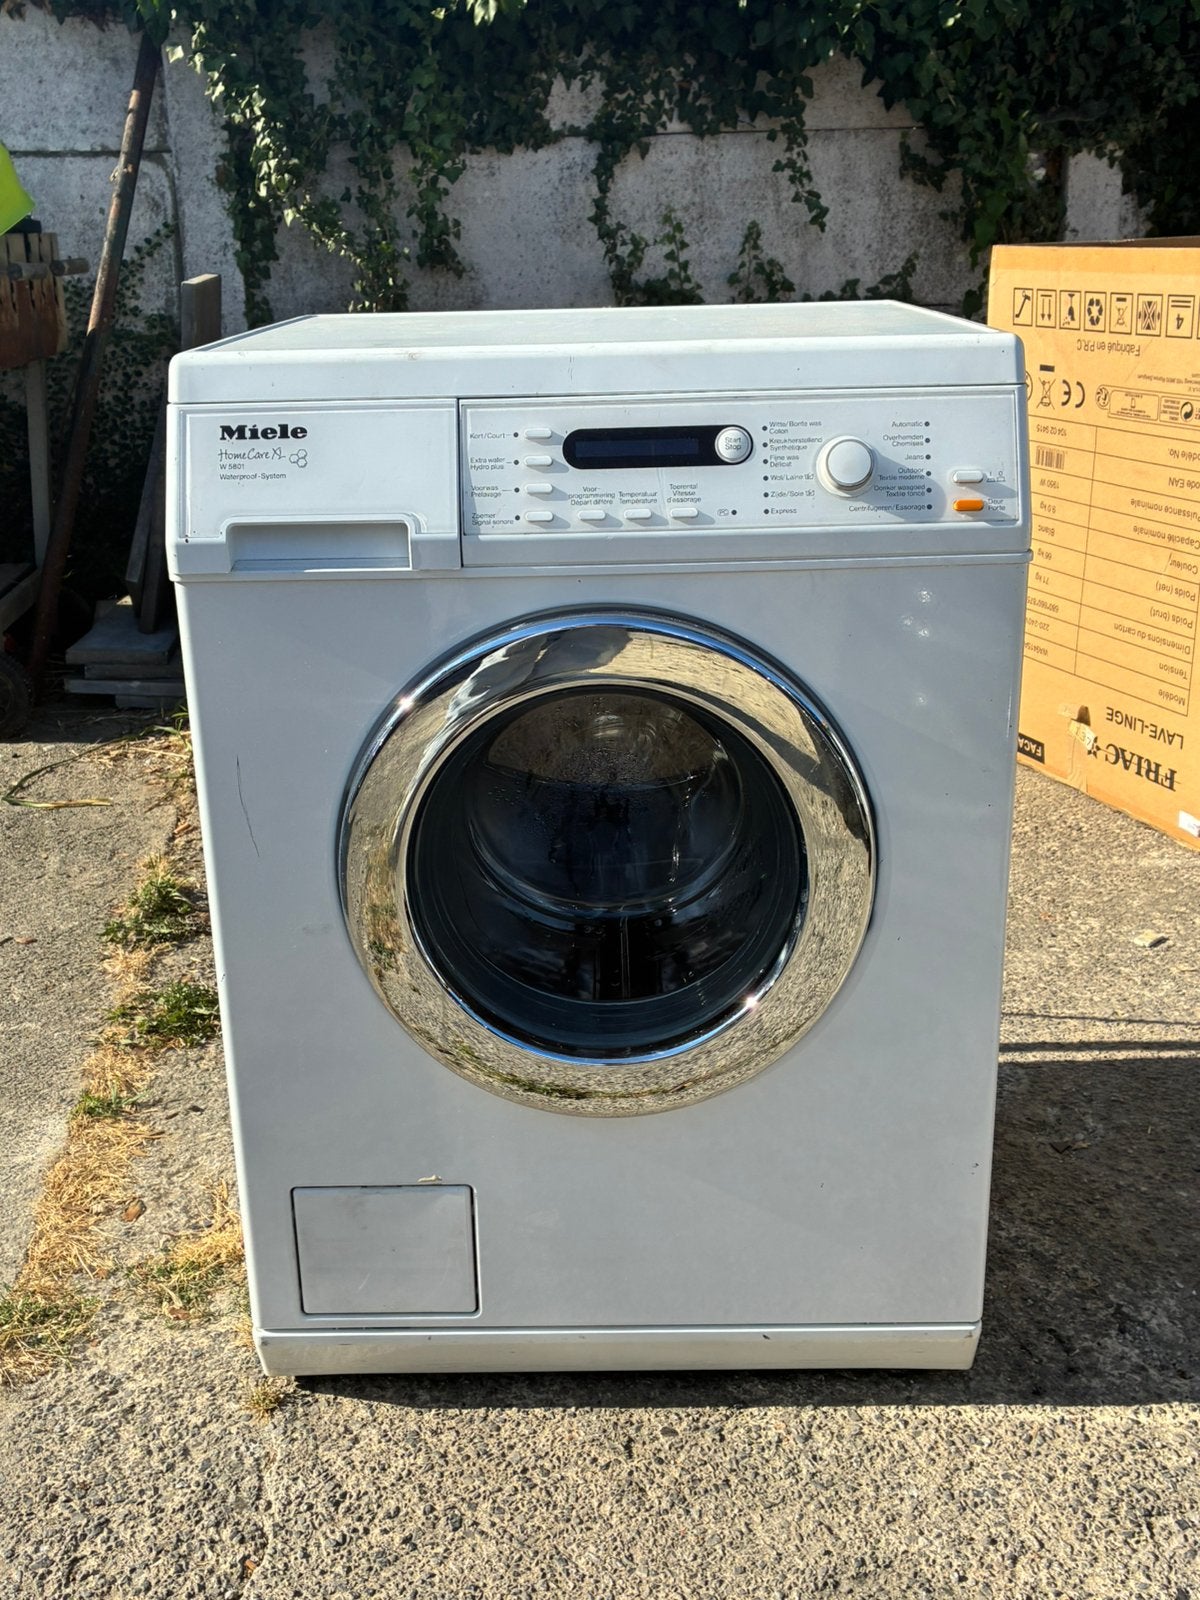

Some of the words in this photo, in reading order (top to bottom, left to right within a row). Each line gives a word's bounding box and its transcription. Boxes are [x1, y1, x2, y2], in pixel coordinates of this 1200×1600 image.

[1096, 341, 1107, 350] en
[219, 423, 309, 440] Miele
[904, 453, 925, 461] Jeans
[1181, 450, 1200, 462] odèle
[470, 464, 490, 472] Hydro
[1168, 477, 1185, 489] EAN
[1187, 480, 1200, 490] ode
[770, 507, 797, 515] Express
[1130, 498, 1162, 513] nominale
[1133, 525, 1165, 541] nominale
[1170, 559, 1199, 575] Couleur
[1156, 580, 1174, 595] (net)
[1175, 588, 1196, 602] Poids
[1149, 607, 1170, 621] (brut)
[1114, 623, 1136, 634] carton
[1170, 615, 1194, 629] Poids
[1137, 631, 1147, 640] du
[1148, 633, 1191, 655] Dimensions
[1159, 663, 1188, 680] Tension
[1158, 690, 1186, 706] Modèle
[1106, 706, 1184, 750] LAVE-LINGE
[1017, 736, 1042, 757] FACA
[1105, 744, 1178, 792] FRIAC
